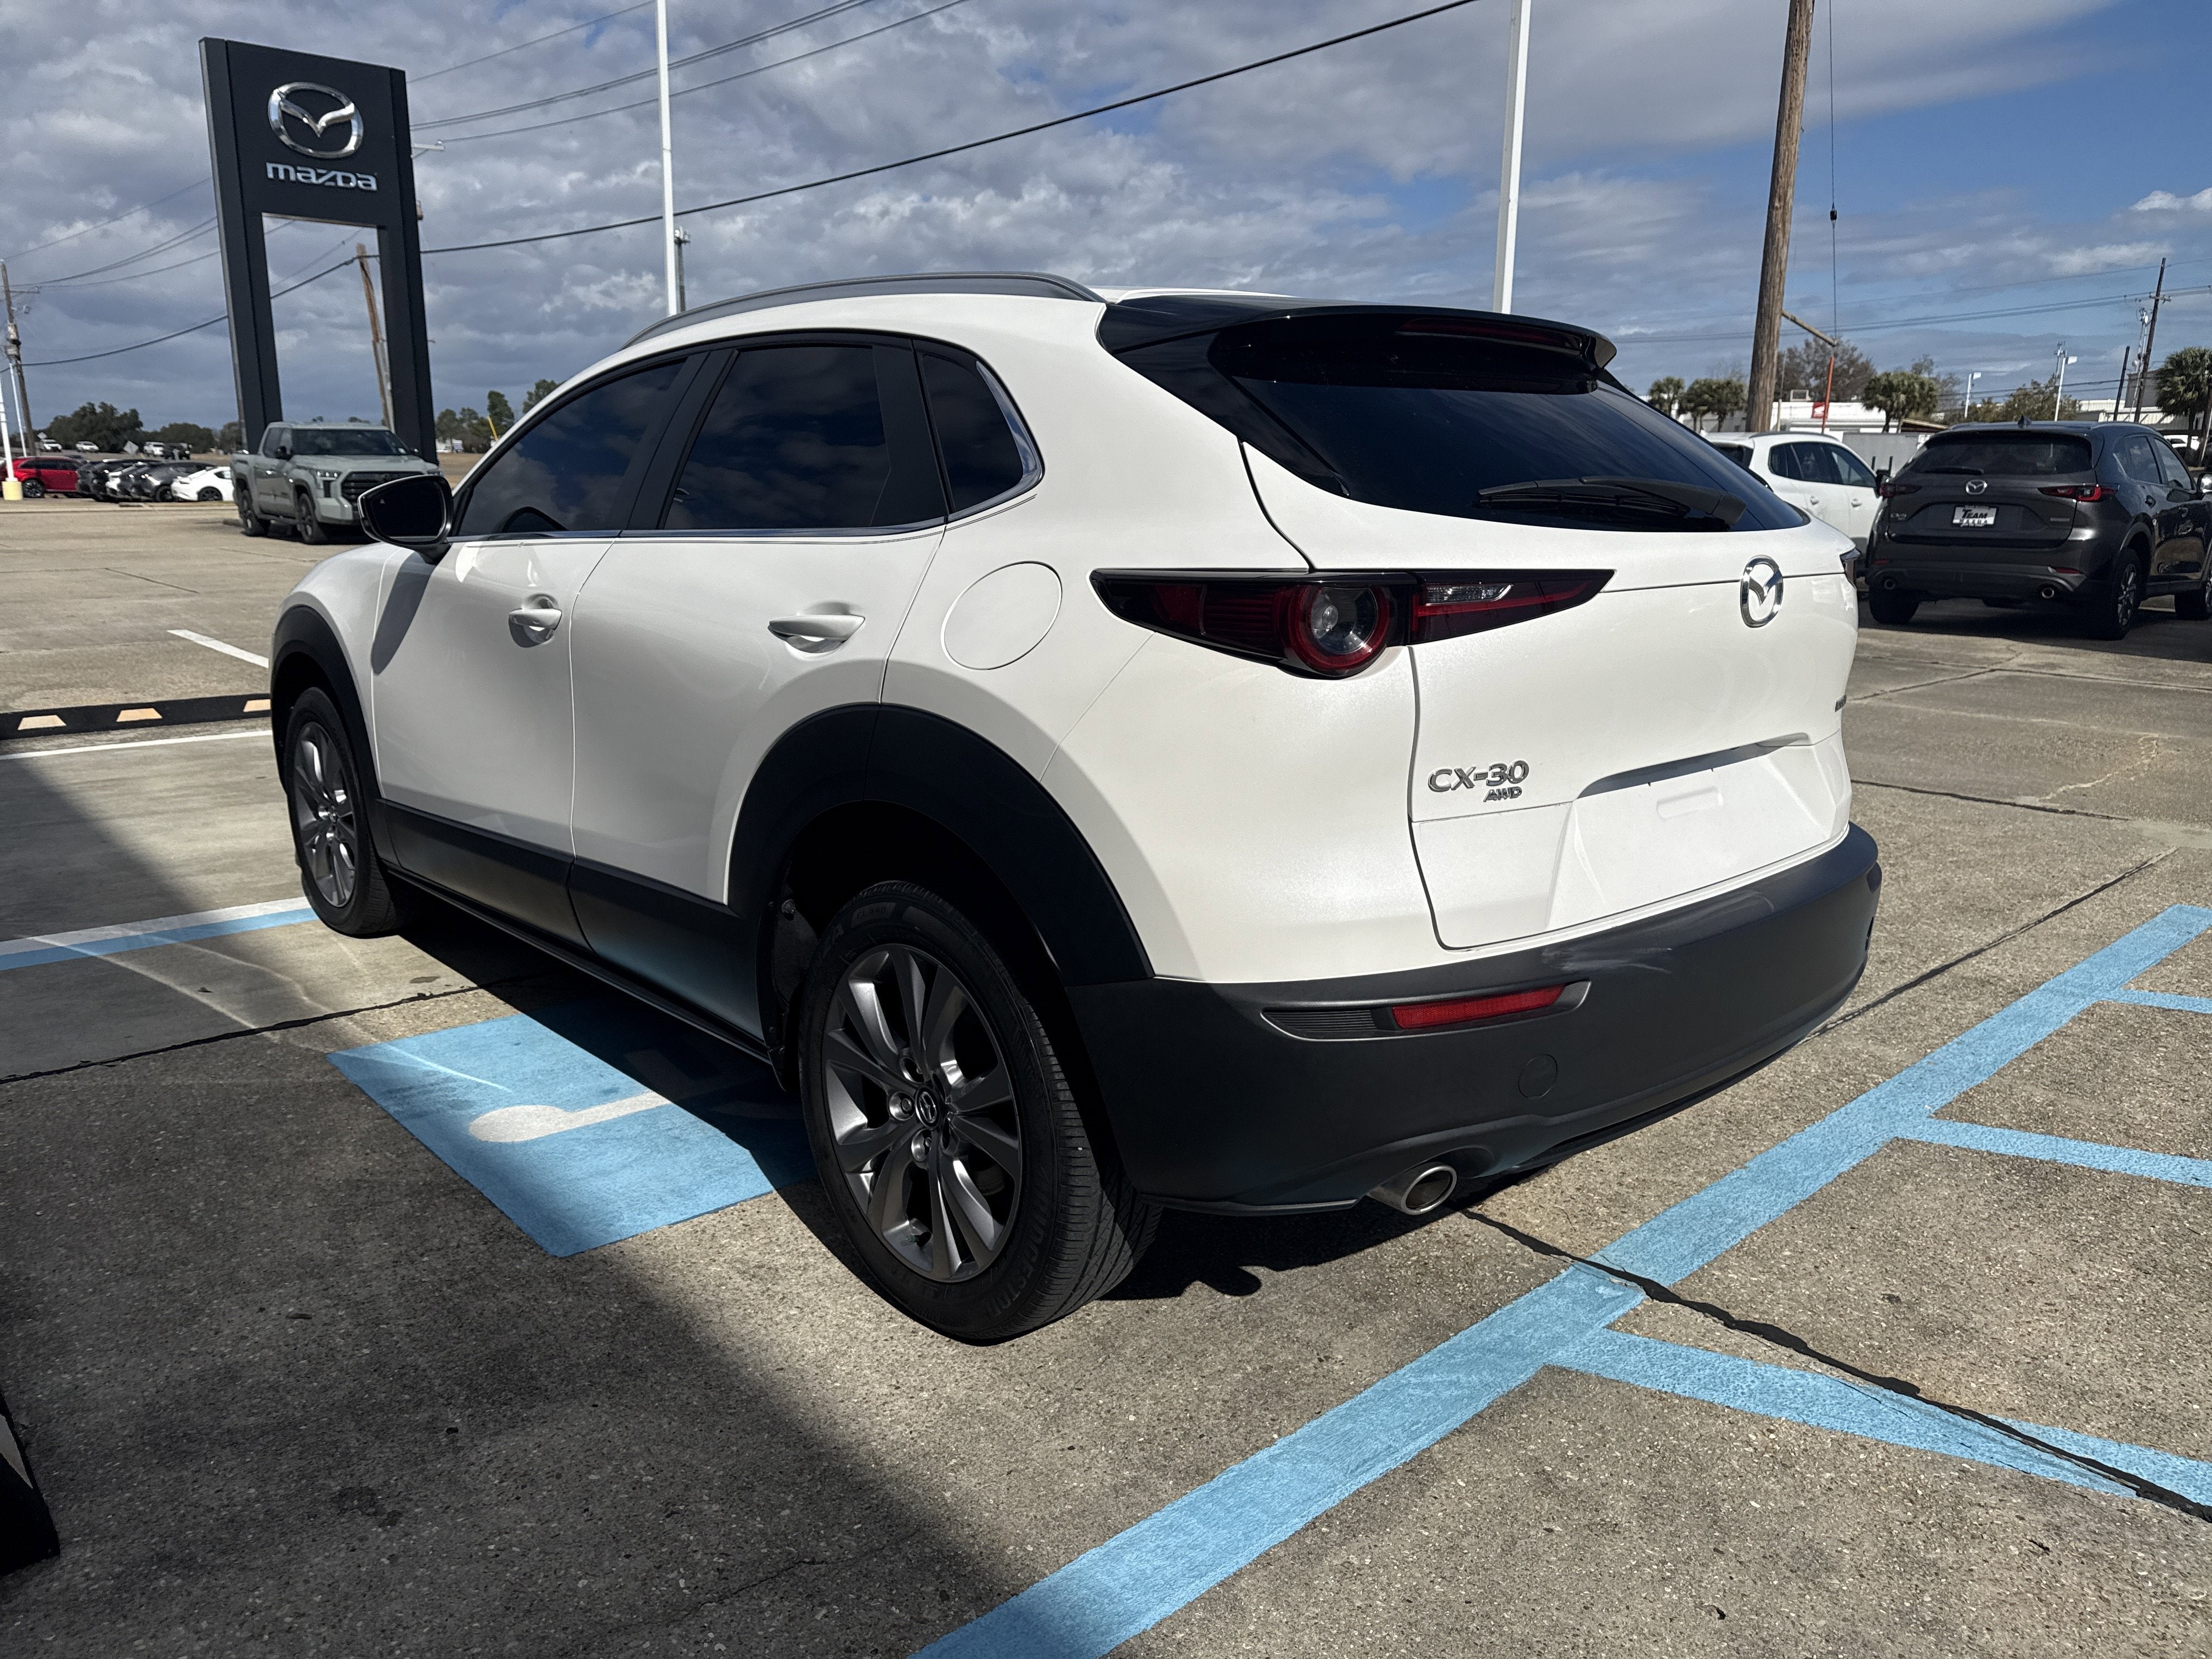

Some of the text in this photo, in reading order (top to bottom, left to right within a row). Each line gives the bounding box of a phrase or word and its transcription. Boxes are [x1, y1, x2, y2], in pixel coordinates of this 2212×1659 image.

[266, 161, 378, 191] mazda
[1962, 509, 1988, 518] TEAM
[1427, 759, 1530, 793] CX-30
[1483, 786, 1522, 803] AWD
